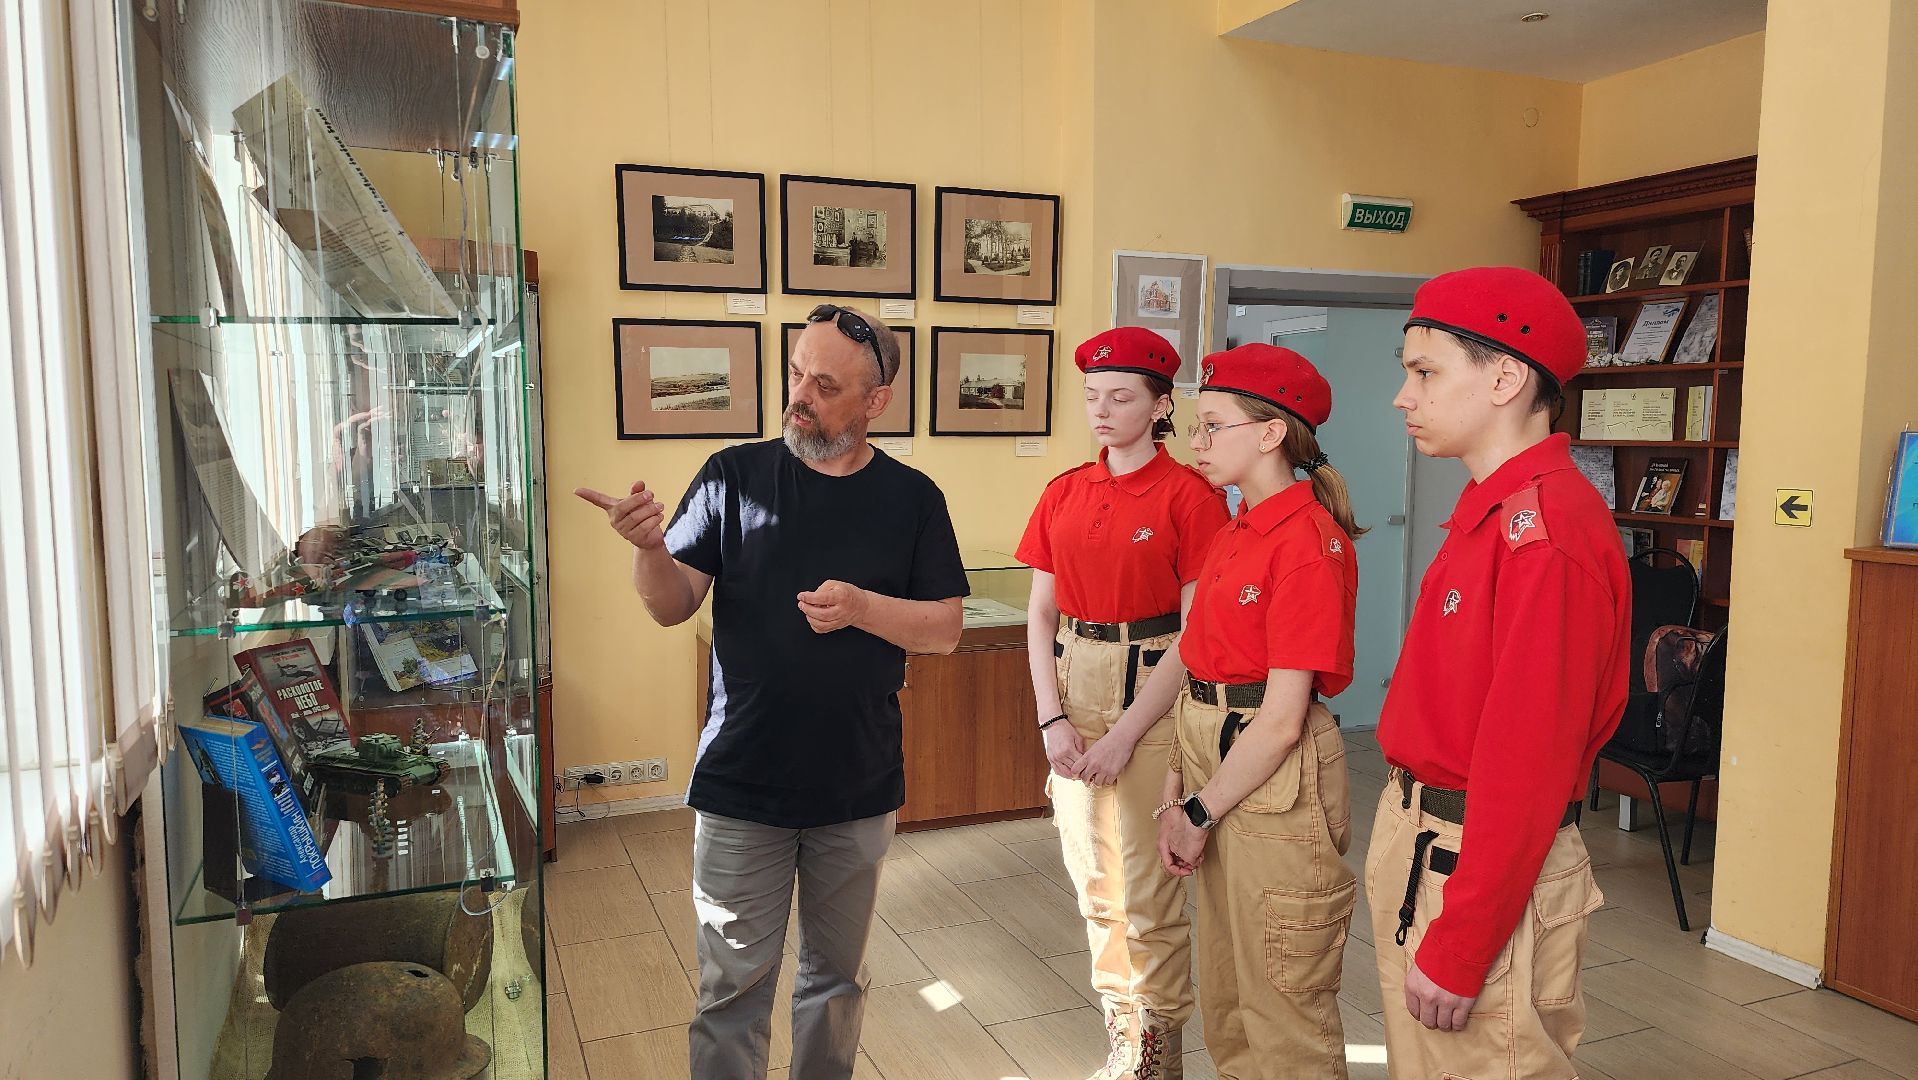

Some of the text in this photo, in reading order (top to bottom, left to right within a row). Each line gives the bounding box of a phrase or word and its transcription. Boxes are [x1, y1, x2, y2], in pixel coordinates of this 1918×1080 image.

[315, 108, 335, 134] Берлин
[334, 136, 356, 165] бомбили
[356, 167, 379, 199] первыми
[1354, 208, 1406, 229] ВЫХОД
[276, 679, 325, 701] РАСКОЛОТОЕ
[294, 692, 319, 710] НЕБО
[288, 825, 309, 863] Александр
[292, 810, 324, 870] ПОКРЫШКИН
